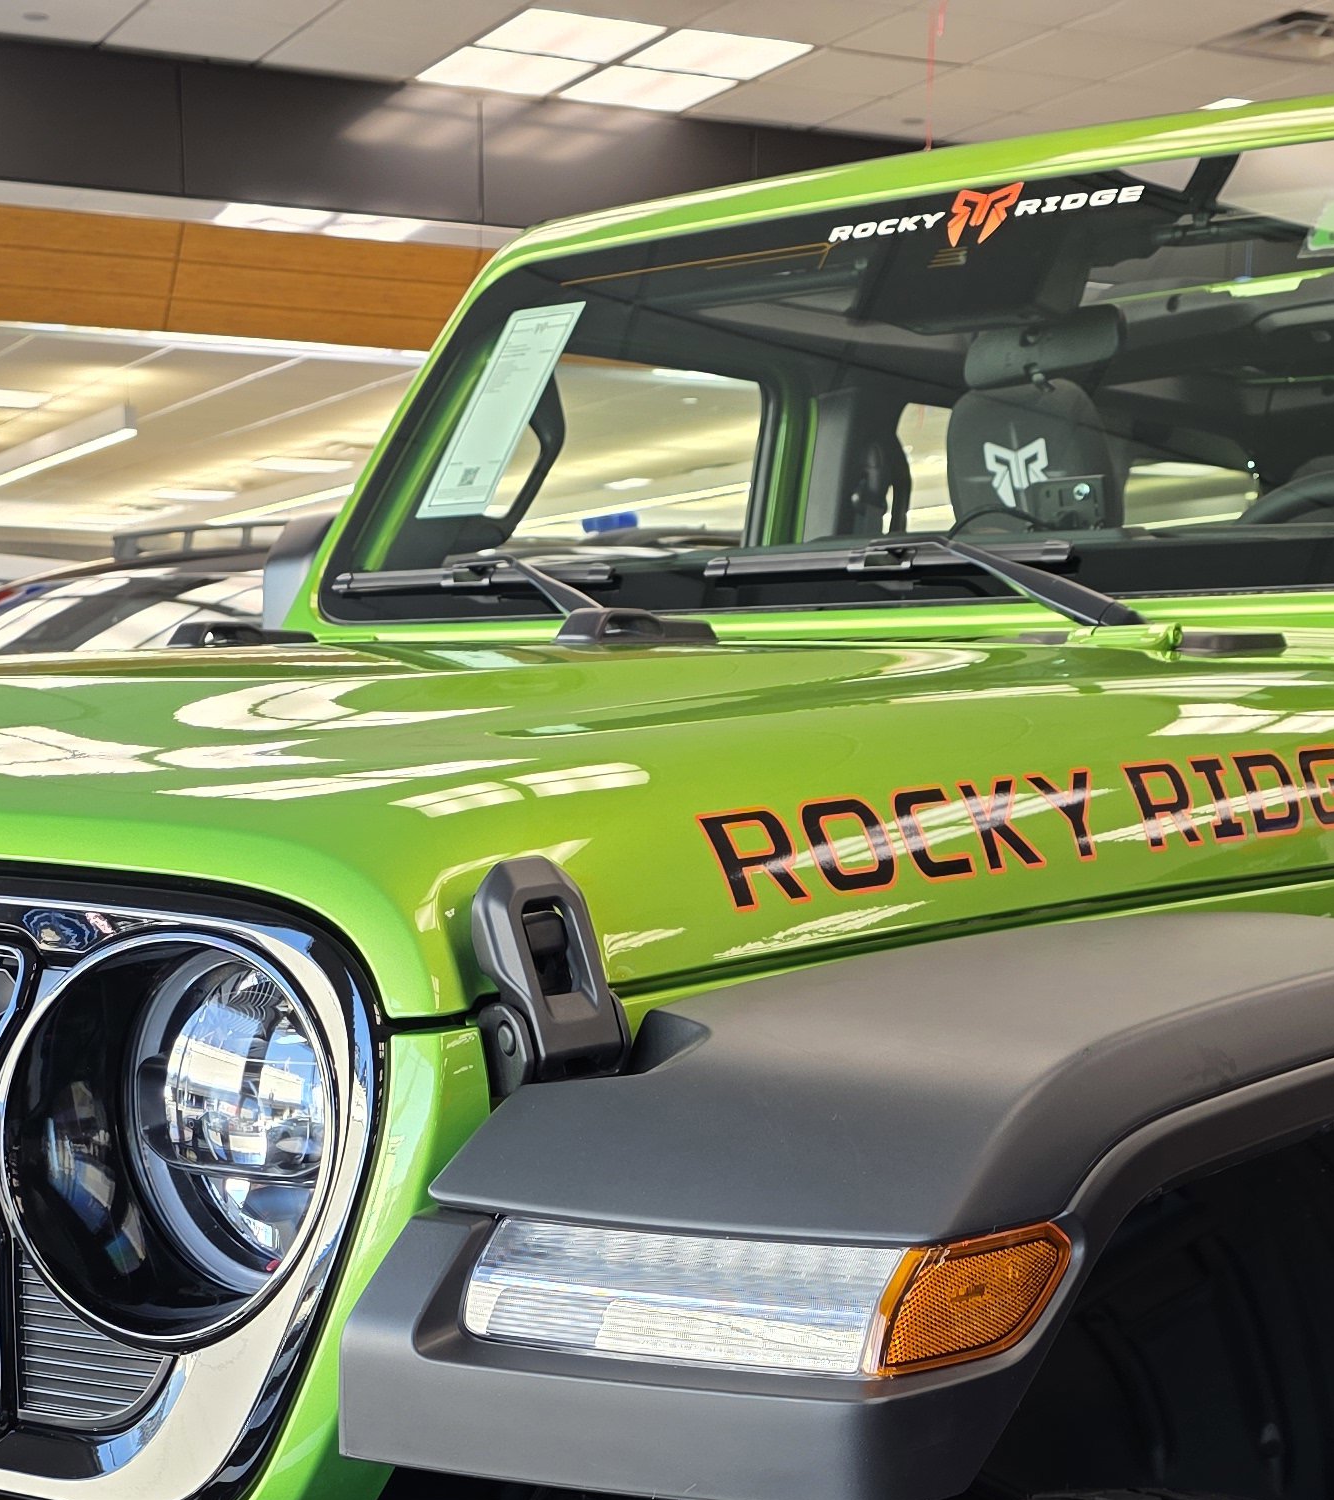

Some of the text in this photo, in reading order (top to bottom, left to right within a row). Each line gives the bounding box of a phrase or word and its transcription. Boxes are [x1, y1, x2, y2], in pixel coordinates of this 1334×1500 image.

[827, 185, 1146, 243] ROCKY RIDGE
[695, 767, 1097, 912] ROCKY
